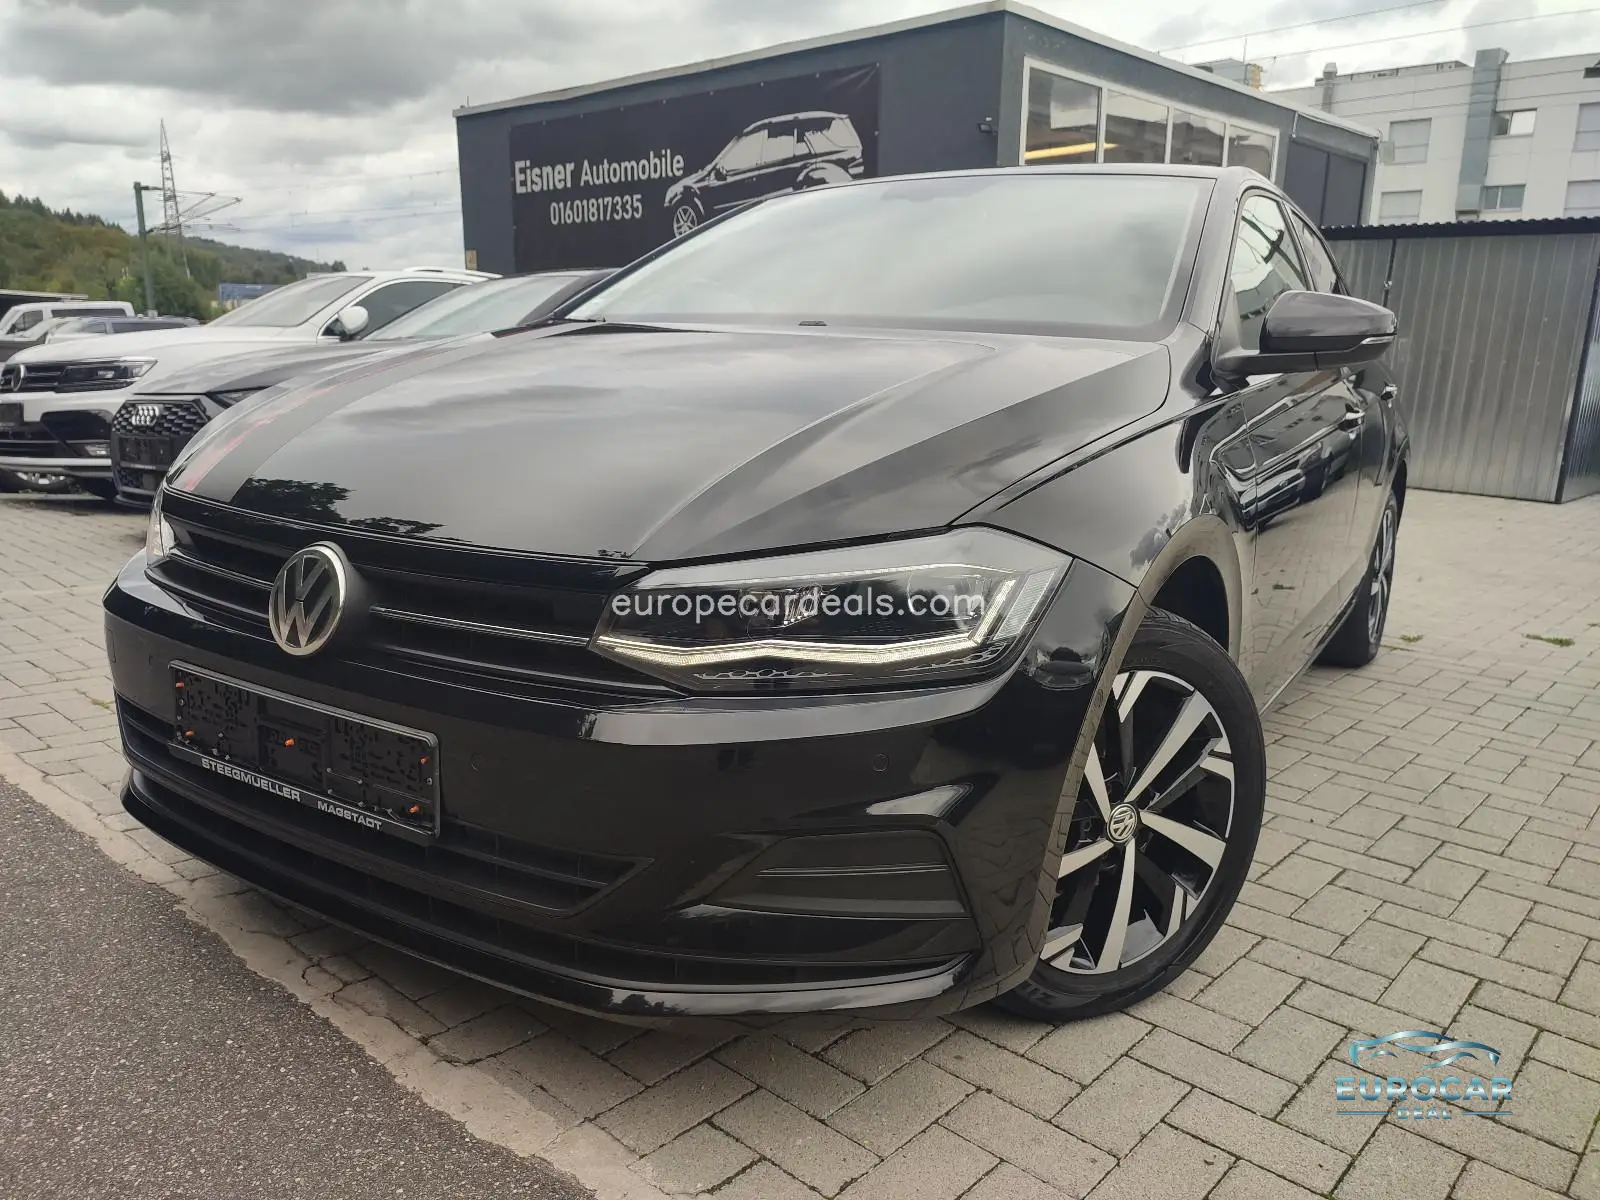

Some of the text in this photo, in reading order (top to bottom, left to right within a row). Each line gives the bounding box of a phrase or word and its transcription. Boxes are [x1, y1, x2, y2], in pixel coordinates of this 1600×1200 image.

[514, 149, 685, 194] Eisner Automobile
[550, 194, 643, 225] 01601817335
[201, 758, 382, 831] STEEGMUELLER MAGSTADT
